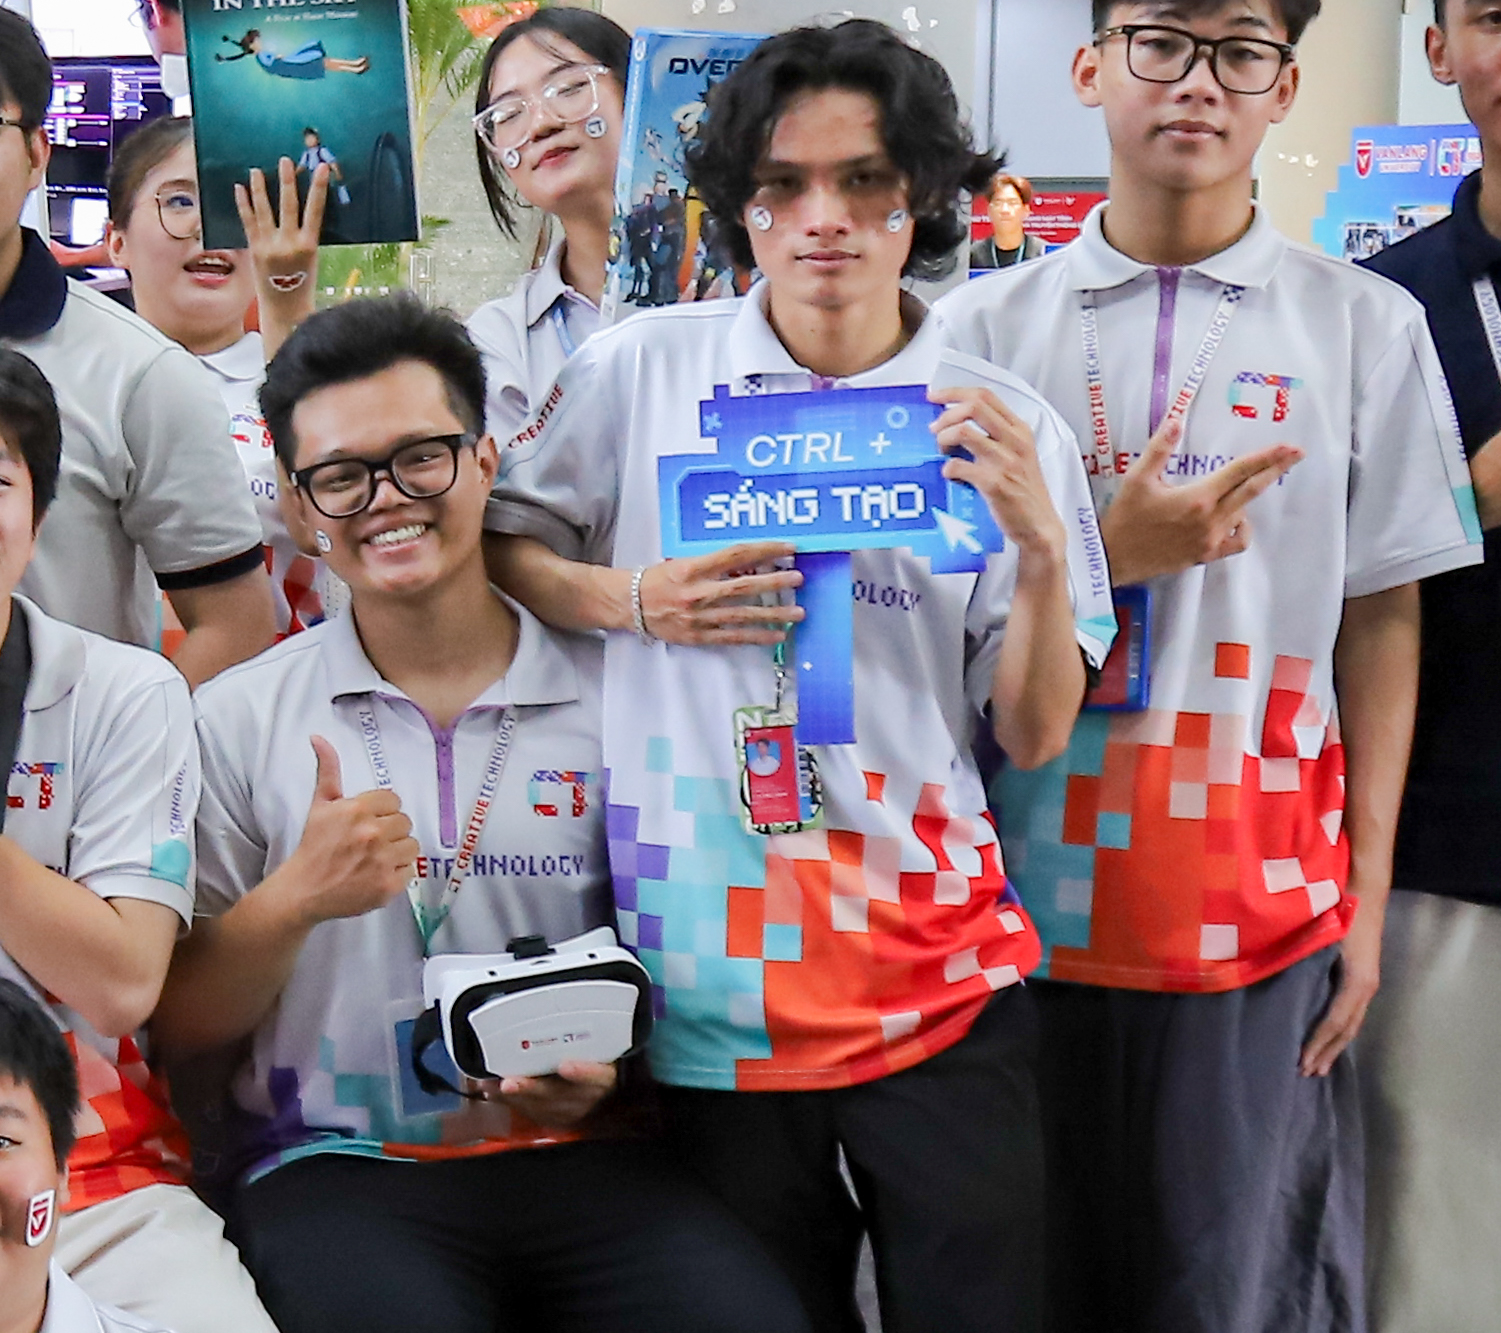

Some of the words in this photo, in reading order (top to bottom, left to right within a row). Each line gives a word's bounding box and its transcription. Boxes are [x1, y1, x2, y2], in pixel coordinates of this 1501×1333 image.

[745, 432, 854, 468] CTRL
[869, 432, 893, 455] +
[703, 478, 819, 531] SÁNG
[830, 482, 925, 530] TẠO
